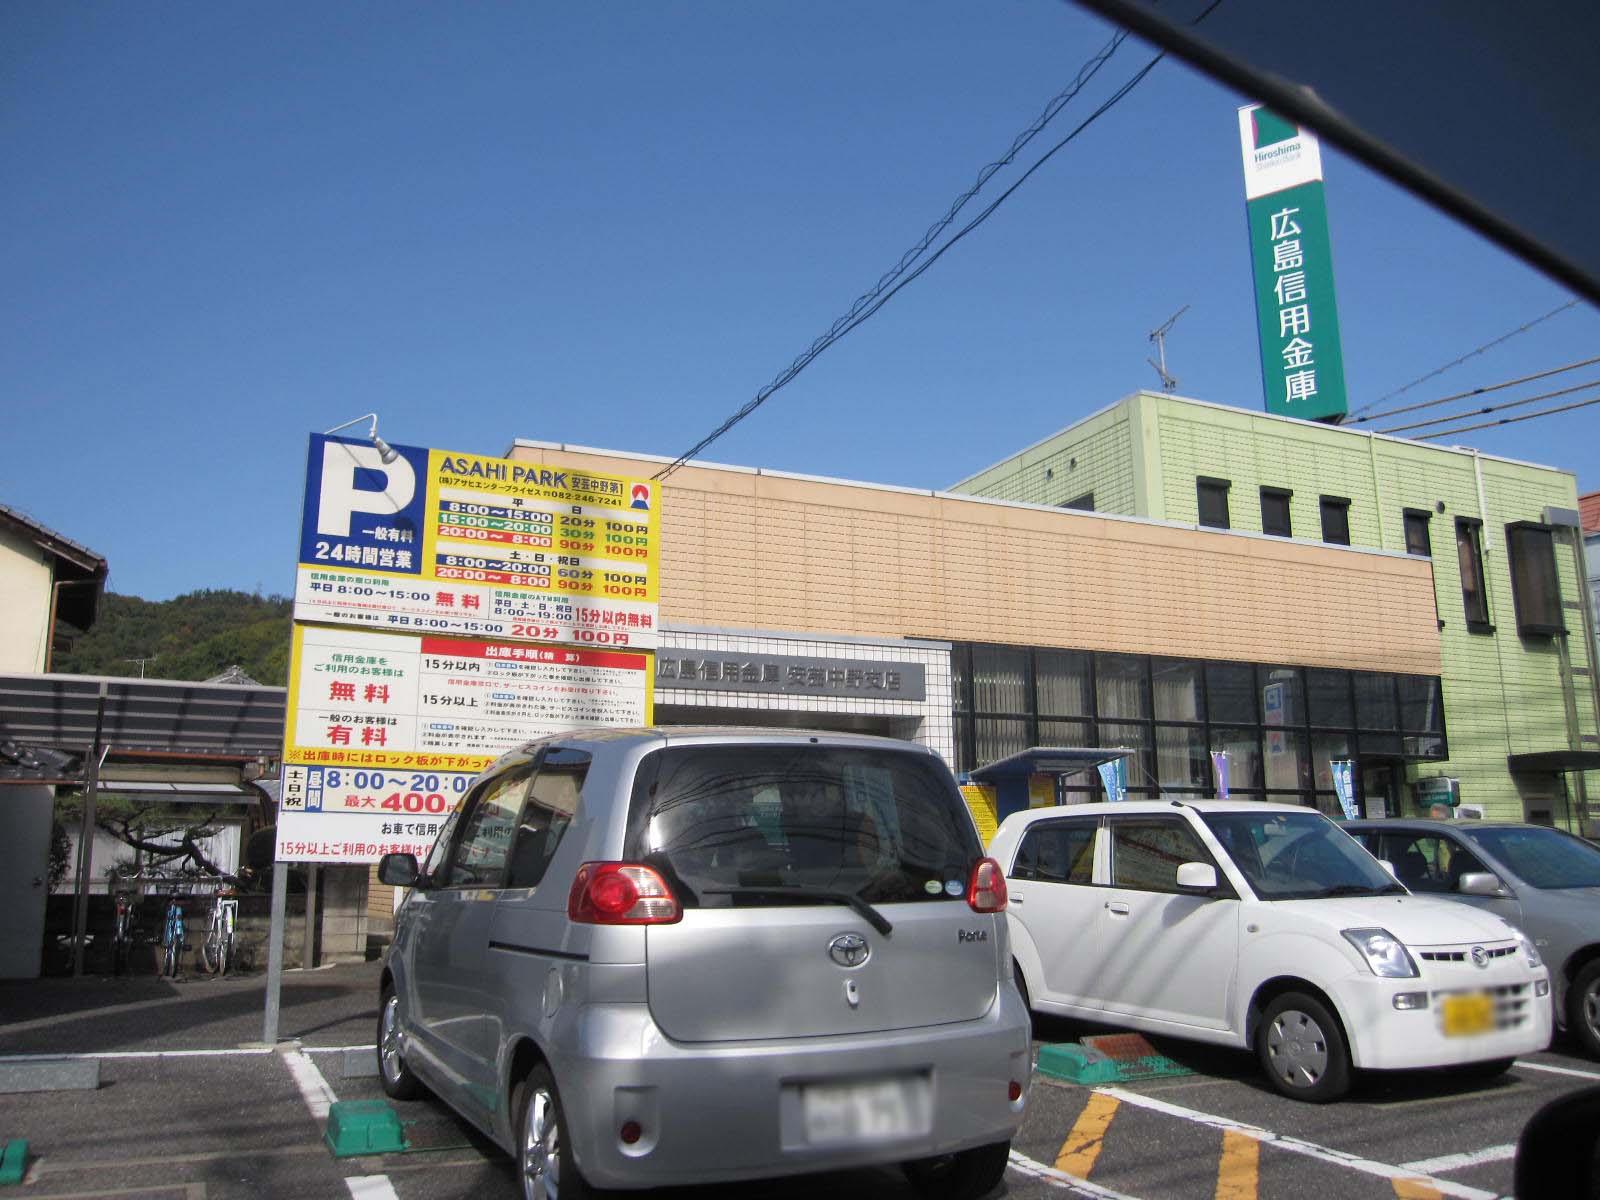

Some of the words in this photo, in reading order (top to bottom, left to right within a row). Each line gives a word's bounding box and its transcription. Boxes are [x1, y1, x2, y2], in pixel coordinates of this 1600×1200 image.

[1254, 143, 1301, 162] Hiroshima
[1270, 208, 1318, 402] 広島信用金庫
[440, 457, 507, 481] ASAHI
[513, 465, 568, 490] PARK
[317, 441, 415, 537] P
[560, 516, 595, 528] 20分
[605, 521, 648, 534] 100円
[362, 526, 413, 543] 一般有料
[560, 527, 595, 540] 30分
[605, 533, 648, 546] 100円
[315, 542, 412, 568] 24時間営業
[559, 539, 595, 551] 90分
[605, 545, 648, 558] 100円
[558, 568, 593, 579] 60分
[604, 572, 647, 585] 100円
[310, 582, 333, 593] 平日
[558, 579, 593, 591] 90分
[603, 584, 647, 597] 100円
[436, 591, 480, 609] 無料
[576, 607, 653, 628] 15分以内無料
[325, 612, 380, 621] 一般のお客様は
[387, 614, 409, 625] 平日
[511, 624, 559, 639] 20分
[573, 629, 629, 645] 100円
[332, 653, 388, 666] 信用金庫を
[425, 658, 480, 672] 15分以内
[314, 664, 404, 677] ご利用のお客様は
[656, 656, 780, 683] 広島信用金庫
[329, 680, 390, 704] 無料
[423, 694, 478, 707] 15分以上
[319, 714, 397, 725] 一般のお客様は
[327, 725, 387, 747] 有料
[344, 795, 376, 808] 最大
